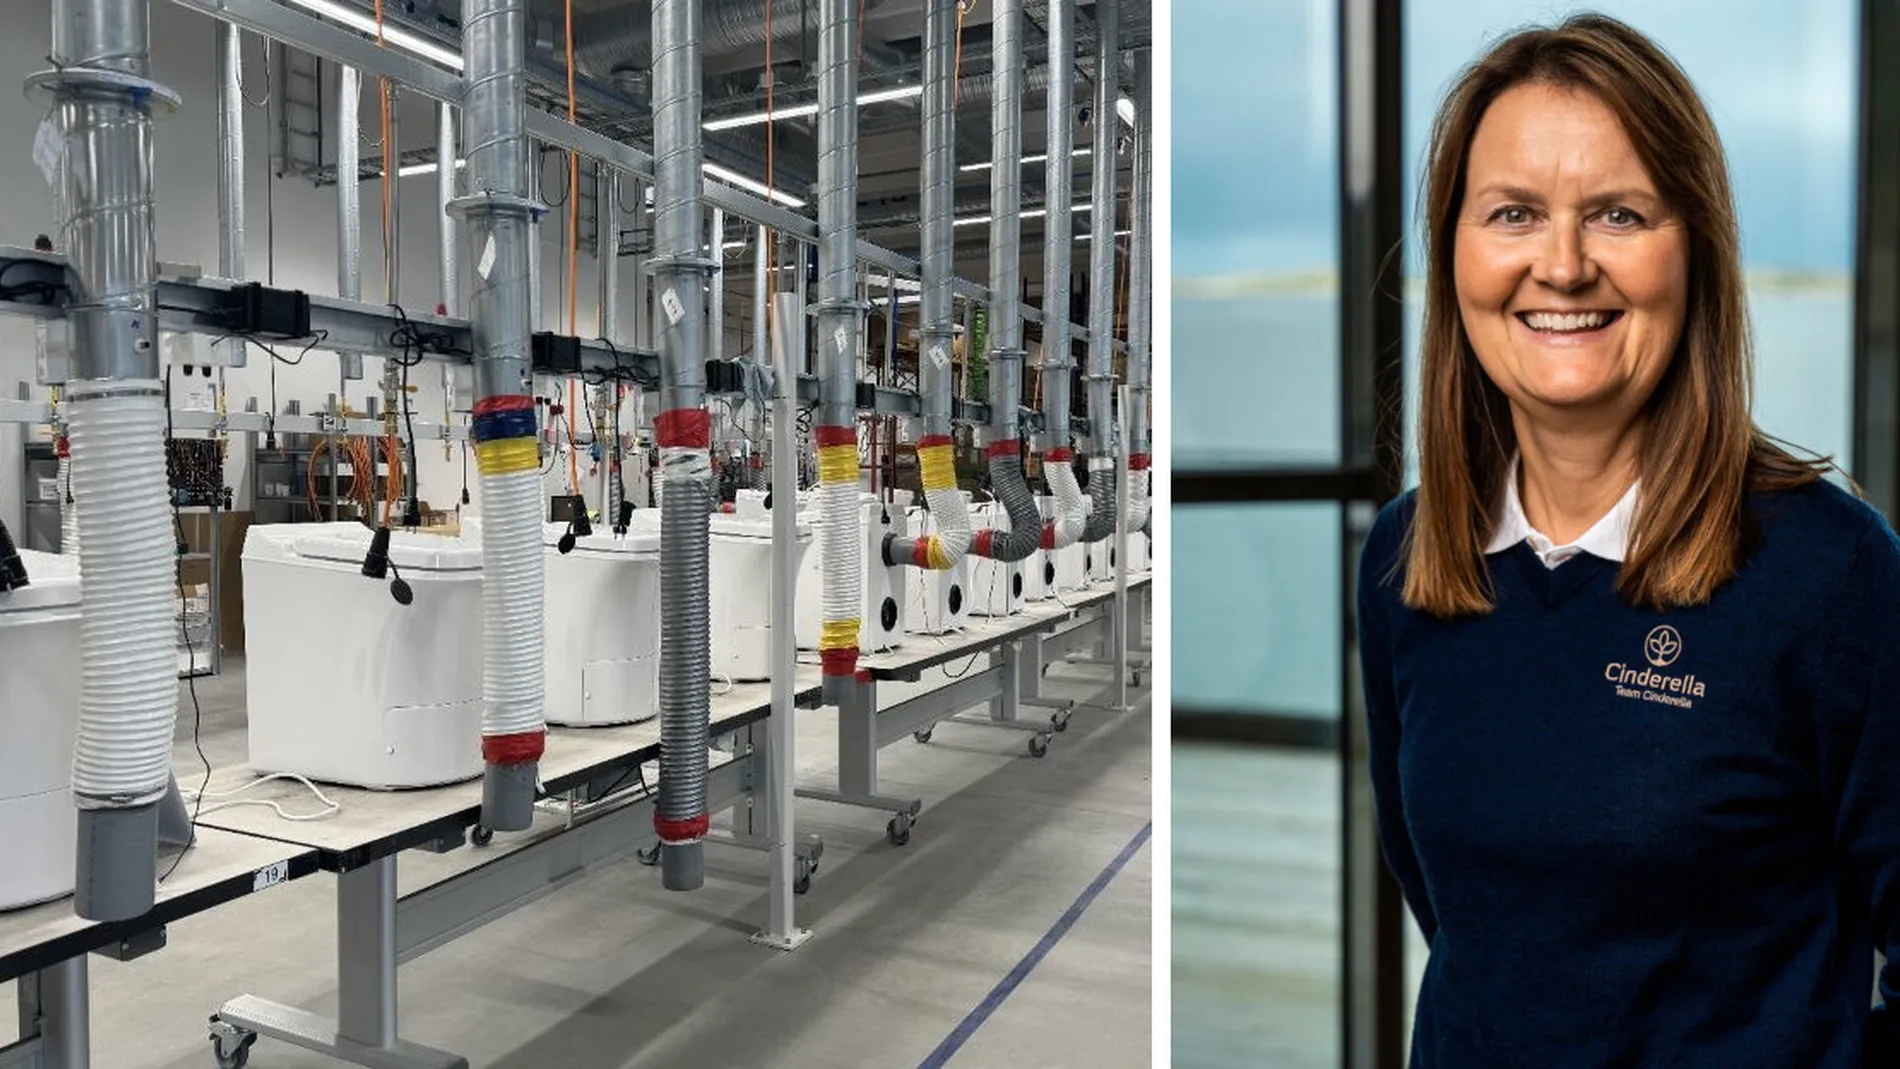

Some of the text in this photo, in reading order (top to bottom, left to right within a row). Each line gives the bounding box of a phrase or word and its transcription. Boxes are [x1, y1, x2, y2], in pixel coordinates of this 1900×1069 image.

[1605, 663, 1705, 698] Cinderella
[1615, 685, 1692, 709] Team Cinderella
[266, 866, 279, 883] 19
